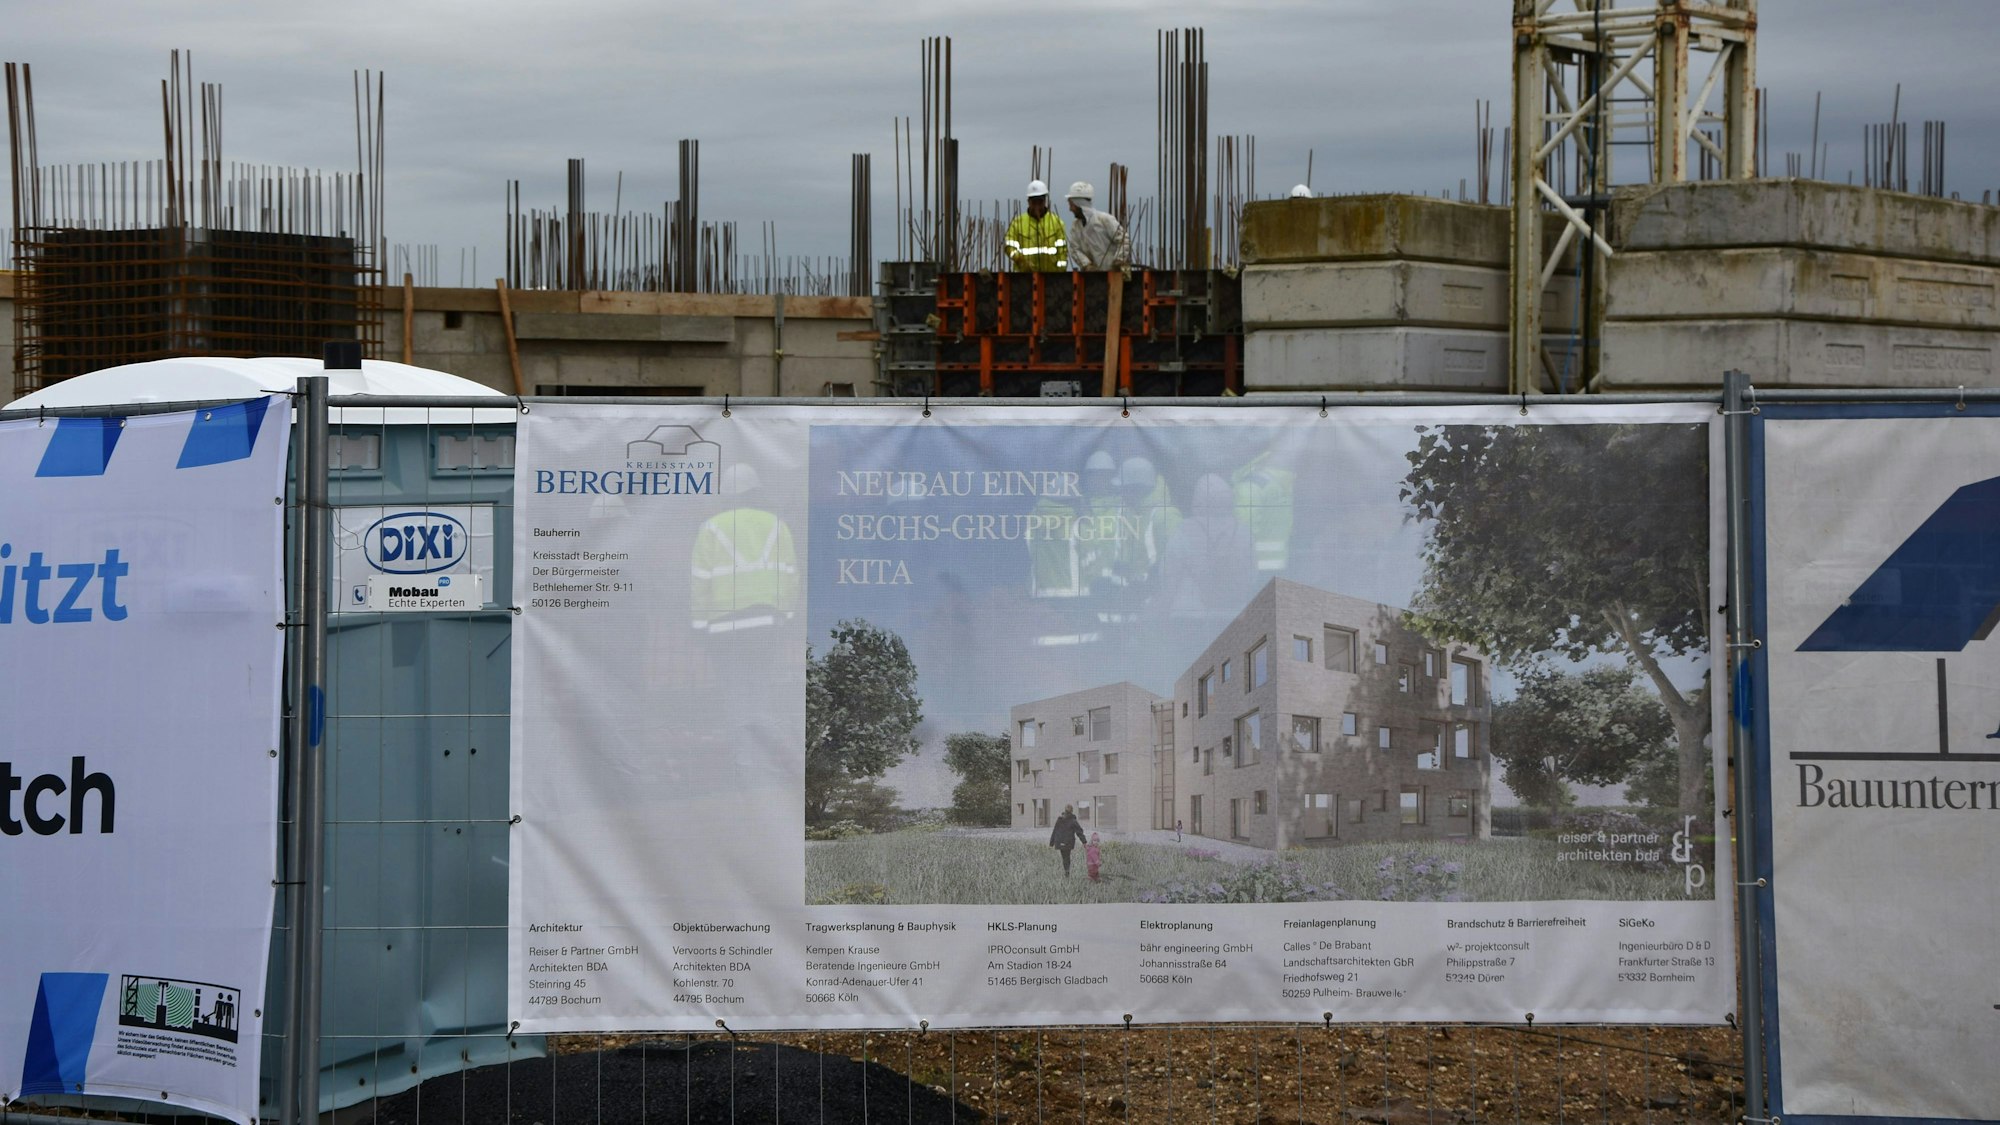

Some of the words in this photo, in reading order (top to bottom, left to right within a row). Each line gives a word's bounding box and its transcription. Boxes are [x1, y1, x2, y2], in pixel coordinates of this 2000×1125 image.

[535, 470, 714, 495] BERGHEIM
[837, 471, 975, 496] NEUBAU
[982, 472, 1082, 496] EINER
[533, 528, 580, 538] Bauherrin
[837, 515, 1141, 541] SECHS-GRUPPIGEN
[533, 551, 580, 561] Kreisstadt
[583, 551, 628, 562] Bergheim
[533, 567, 548, 577] Der
[552, 567, 619, 578] Bürgermeister
[837, 559, 913, 585] KITA
[389, 587, 439, 597] Mobau
[533, 582, 593, 592] Bethlehemer
[596, 582, 611, 592] Str.
[614, 583, 633, 592] 9-11
[389, 599, 416, 607] Echte
[421, 600, 465, 608] Experten
[532, 598, 561, 608] 50126
[564, 598, 610, 609] Bergheim
[1558, 833, 1593, 843] reiser
[1598, 831, 1606, 842] &
[1611, 833, 1660, 845] partner
[1557, 849, 1631, 861] architekten
[1636, 850, 1660, 861] bda
[806, 922, 894, 933] Tragwerksplanung
[898, 922, 904, 931] &
[907, 922, 956, 932] Bauphysik
[987, 922, 1057, 932] HKLS-Planung
[1140, 921, 1213, 931] Elektroplanung
[1284, 918, 1376, 929] Freianlagenplanung
[1447, 919, 1505, 928] Brandschutz
[1508, 919, 1514, 927] &
[1517, 918, 1586, 928] Barrierefreiheit
[1619, 918, 1655, 927] SiGeKo
[529, 923, 583, 933] Architektur
[673, 923, 771, 933] Objektüberwachung
[529, 947, 558, 956] Reiser
[561, 947, 568, 955] &
[571, 946, 604, 955] Partner
[608, 946, 639, 955] GmbH
[673, 947, 717, 955] Vervoorts
[720, 947, 726, 955] &
[729, 946, 773, 955] Schindler
[806, 946, 845, 956] Kempen
[848, 946, 880, 954] Krause
[988, 945, 1046, 954] IPROconsult
[1049, 944, 1080, 954] GmbH
[1140, 944, 1160, 953] bähr
[1164, 944, 1219, 955] engineering
[1223, 943, 1253, 953] GmbH
[1284, 942, 1310, 951] Calles
[1319, 941, 1332, 950] De
[1335, 941, 1371, 950] Brabant
[1465, 942, 1530, 952] projektconsult
[1619, 942, 1683, 952] Ingenieurbüro
[1686, 941, 1694, 950] D
[1696, 942, 1702, 950] &
[1704, 941, 1710, 950] D
[806, 962, 854, 971] Beratende
[858, 962, 907, 972] Ingenieure
[910, 961, 940, 970] GmbH
[988, 961, 1004, 970] Am
[1007, 961, 1043, 970] Stadion
[1047, 961, 1072, 969] 18-24
[1140, 959, 1212, 968] Johannisstraße
[1215, 959, 1227, 968] 64
[1284, 957, 1391, 967] Landschaftsarchitekten
[1394, 958, 1414, 967] GbR
[1447, 958, 1506, 968] Philippstraße
[1510, 958, 1514, 966] 7
[1619, 958, 1668, 966] Frankfurter
[1671, 957, 1702, 966] Straße
[1706, 957, 1714, 966] 13
[529, 963, 583, 972] Architekten
[587, 963, 608, 971] BDA
[673, 963, 726, 971] Architekten
[729, 963, 751, 971] BDA
[806, 977, 909, 987] Konrad-Adenauer-Ufer
[912, 978, 923, 986] 41
[988, 977, 1017, 986] 51465
[1020, 976, 1061, 986] Bergisch
[1064, 975, 1108, 985] Gladbach
[1140, 975, 1169, 983] 50668
[1172, 974, 1192, 984] Köln
[1283, 972, 1344, 983] Friedhofsweg
[1347, 973, 1358, 981] 21
[1478, 973, 1504, 982] Düren
[1650, 972, 1695, 982] Bornheim
[529, 980, 571, 989] Steinring
[574, 979, 586, 988] 45
[673, 979, 719, 987] Kohlenstr.
[722, 979, 734, 987] 70
[806, 994, 835, 1002] 50668
[838, 992, 859, 1002] Köln
[1283, 989, 1310, 998] 50259
[1313, 988, 1353, 998] Pulheim-
[529, 996, 557, 1004] 44789
[561, 995, 601, 1004] Bochum
[673, 995, 702, 1003] 44795
[706, 995, 744, 1003] Bochum
